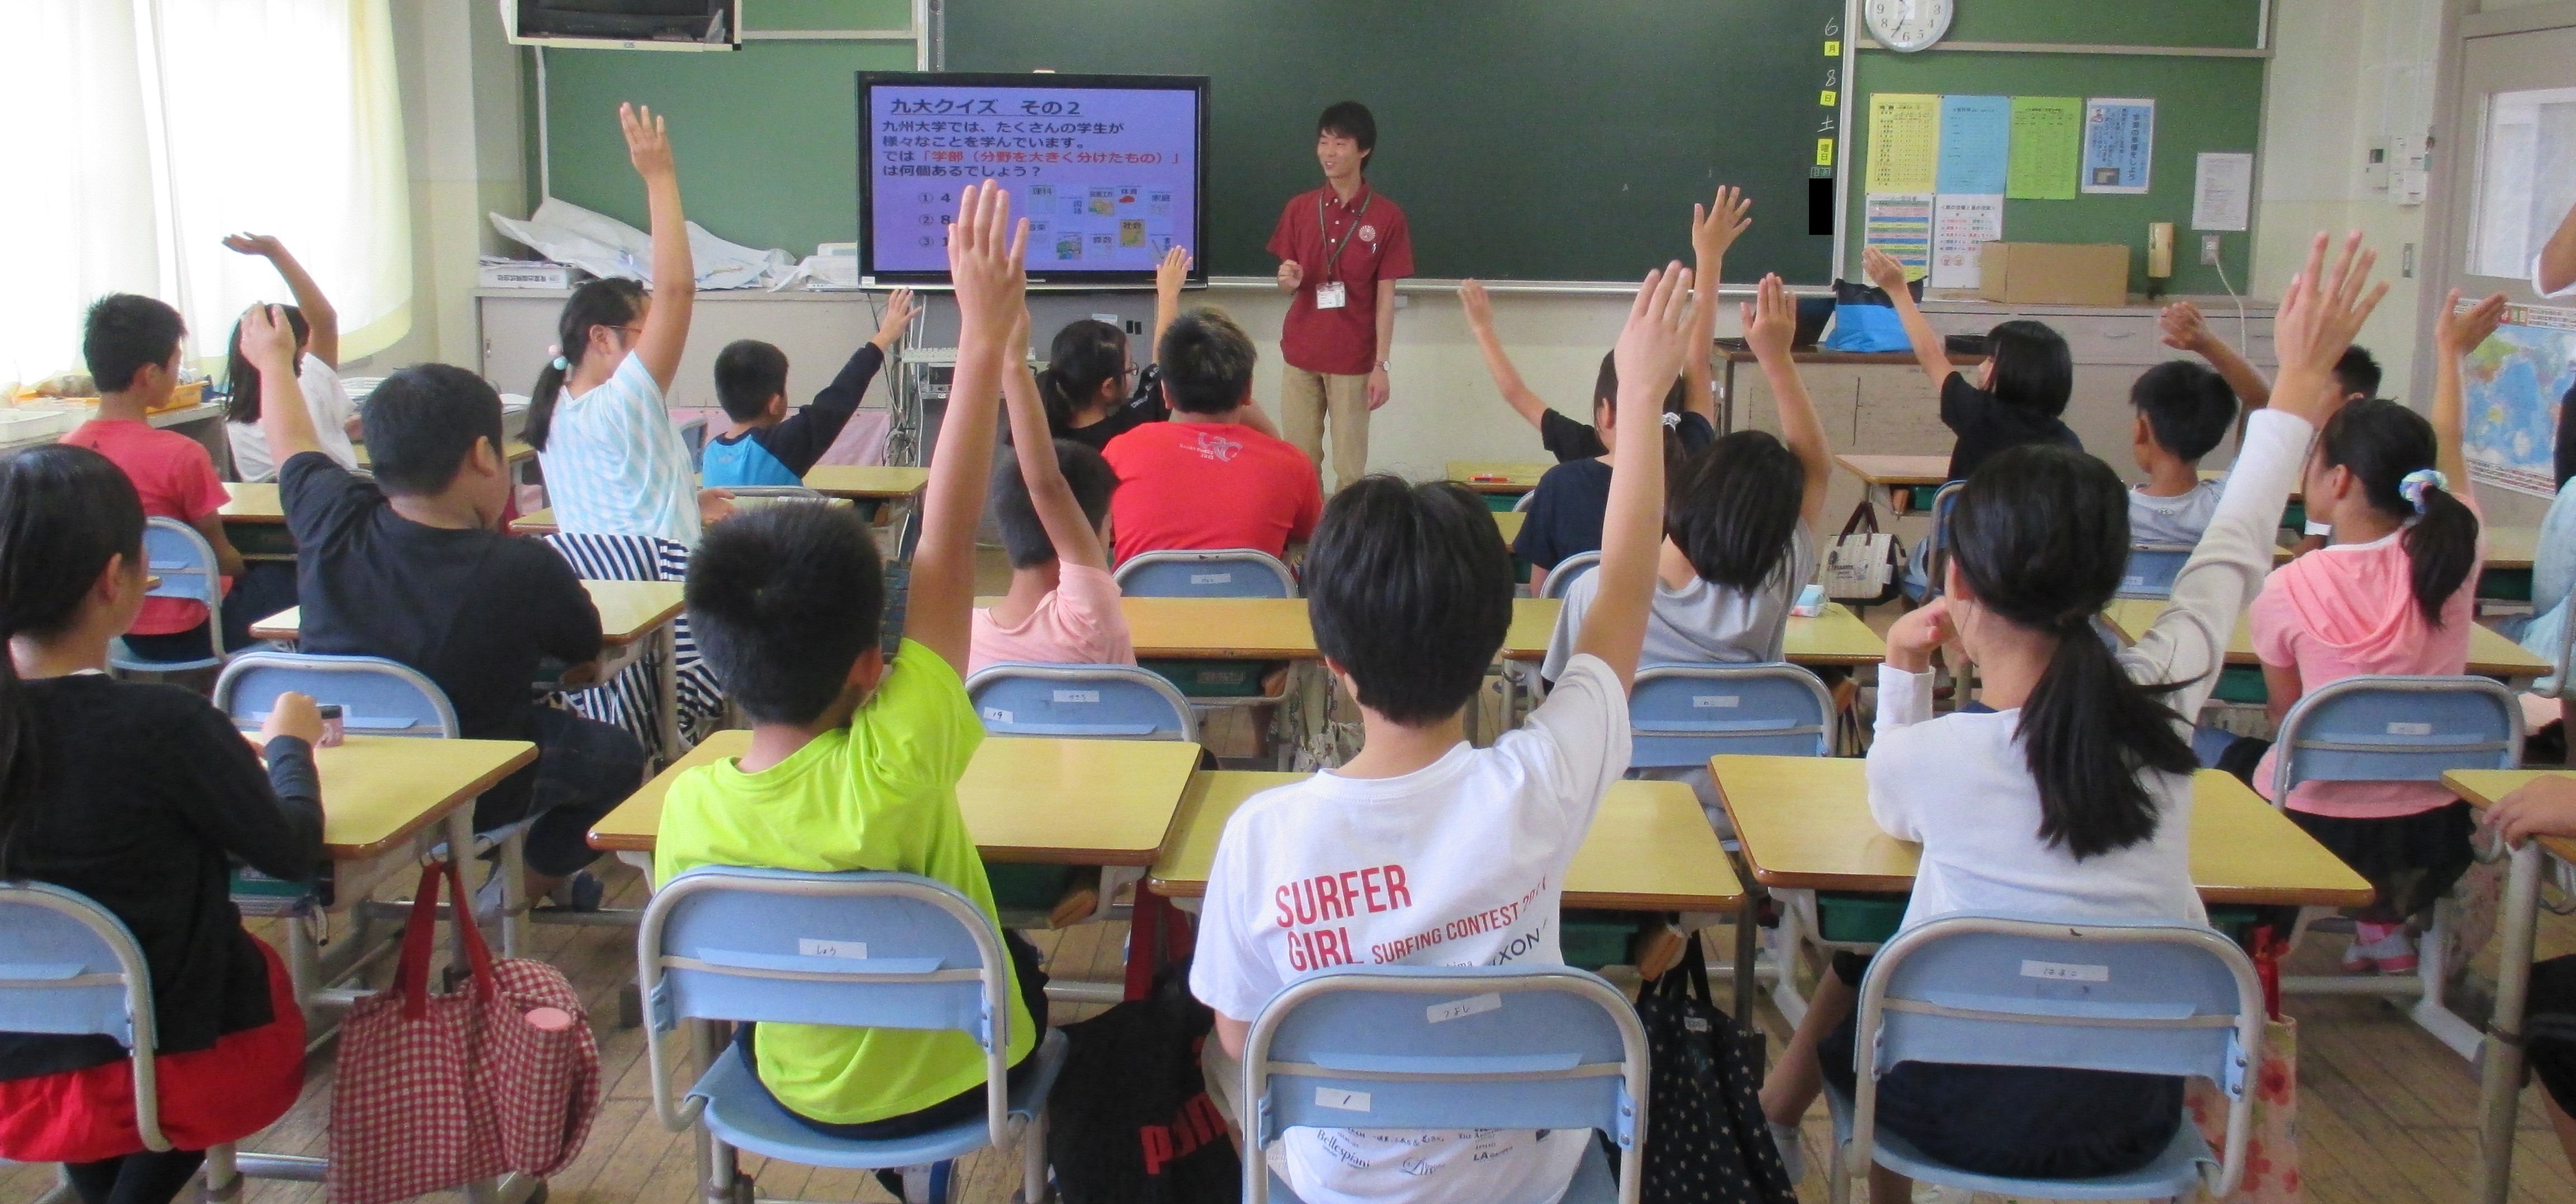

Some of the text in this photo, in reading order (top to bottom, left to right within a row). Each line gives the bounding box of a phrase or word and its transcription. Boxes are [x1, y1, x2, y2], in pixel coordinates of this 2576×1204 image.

[1877, 4, 1884, 14] 9
[1933, 4, 1941, 15] 3
[1825, 17, 1838, 36] 6
[1881, 18, 1888, 28] 8
[1928, 18, 1935, 29] 4
[1902, 31, 1910, 41] 6
[1917, 29, 1924, 39] 5
[1825, 69, 1836, 87] 8
[891, 98, 999, 114] 九大クイズ
[882, 120, 1125, 134] 九州大学では、たくさんの学生が
[1817, 115, 1834, 133] 土
[883, 135, 1083, 148] 様々なことを学んでいます。
[1821, 144, 1829, 161] 曜日
[941, 193, 951, 203] 4
[940, 215, 950, 225] 8
[1275, 865, 1412, 929] SURFER
[1287, 926, 1364, 972] GIRL
[1371, 928, 1442, 965] SURFING
[1446, 902, 1519, 942] CONTEST
[1317, 1129, 1370, 1168] Bellespiani
